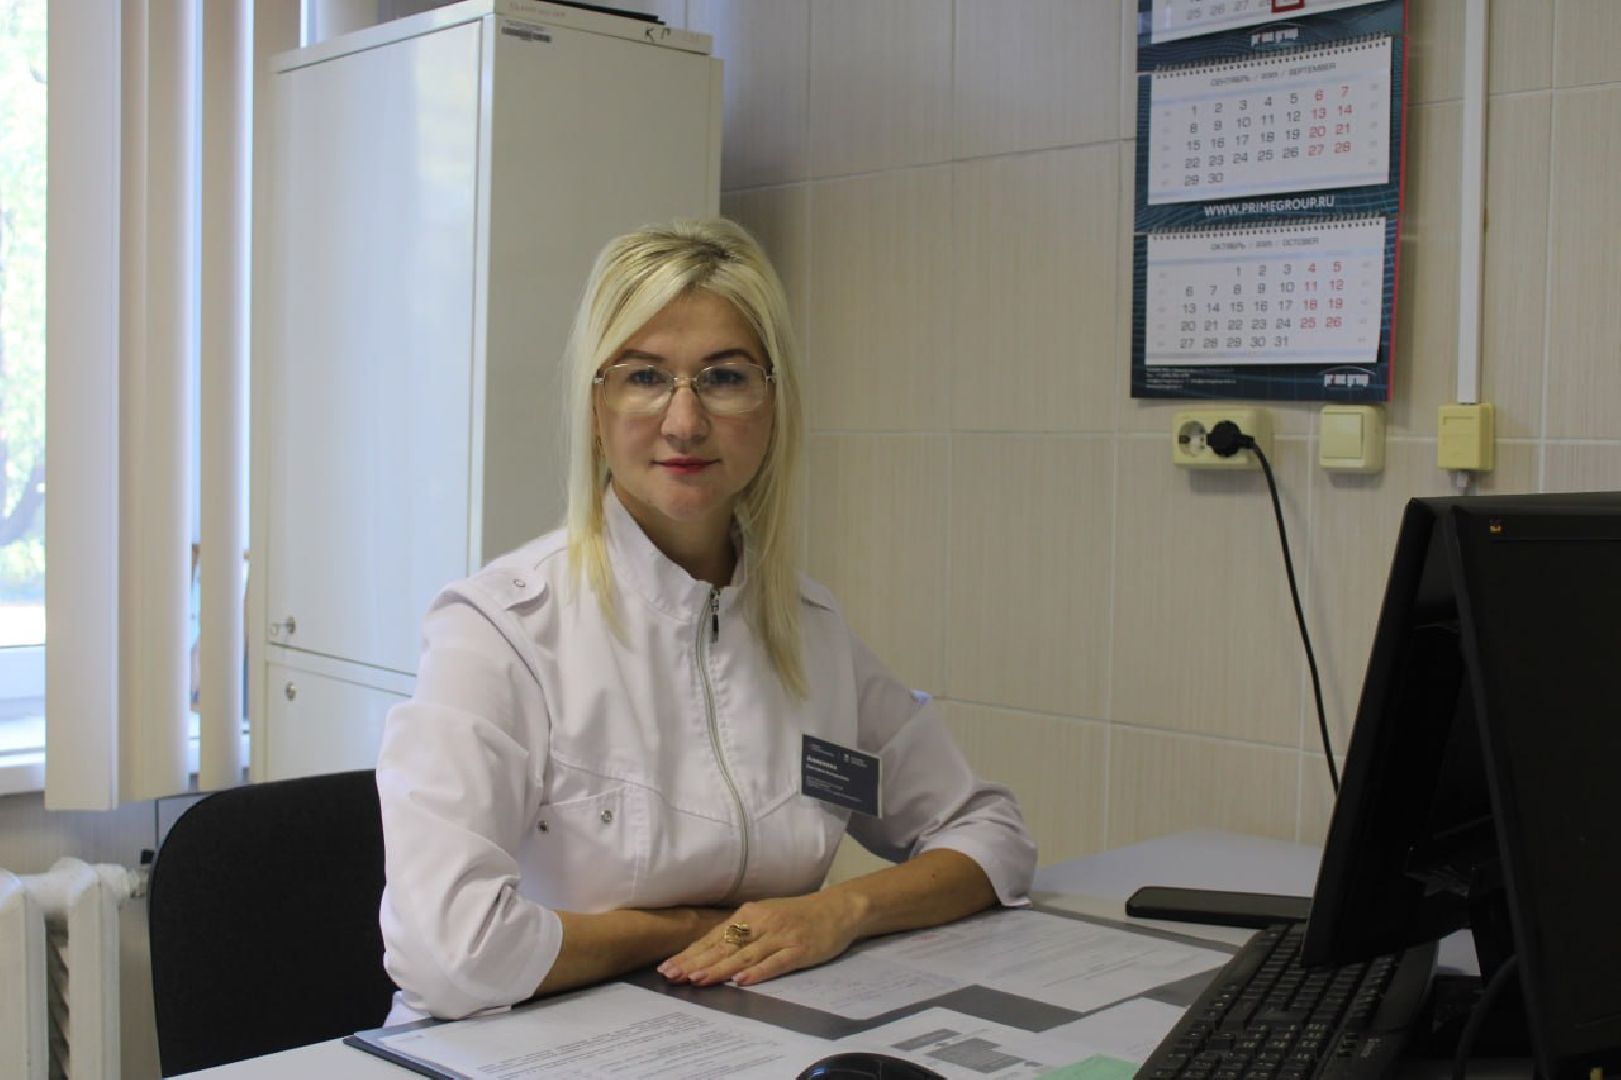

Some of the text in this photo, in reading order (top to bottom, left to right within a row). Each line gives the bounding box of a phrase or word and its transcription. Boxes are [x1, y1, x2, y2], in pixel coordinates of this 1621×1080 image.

[1192, 86, 1349, 116] 1 2 3 4 5 6 7
[1190, 104, 1352, 134] 8 9 10 11 12 13 14
[1187, 122, 1350, 151] 15 16 17 18 19 20 21
[1185, 141, 1351, 168] 22 23 24 25 26 27 28
[1184, 172, 1224, 187] 29 30
[1204, 196, 1335, 217] WWW.PRIMEGROUP.RU
[1236, 262, 1342, 277] 1 2 3 4 5
[1185, 279, 1344, 297] 6 7 8 9 10 11 12
[1182, 297, 1343, 314] 13 14 15 16 17 18 19
[1180, 316, 1342, 332] 20 21 22 23 24 25 26
[1180, 335, 1289, 349] 27 28 29 30 31
